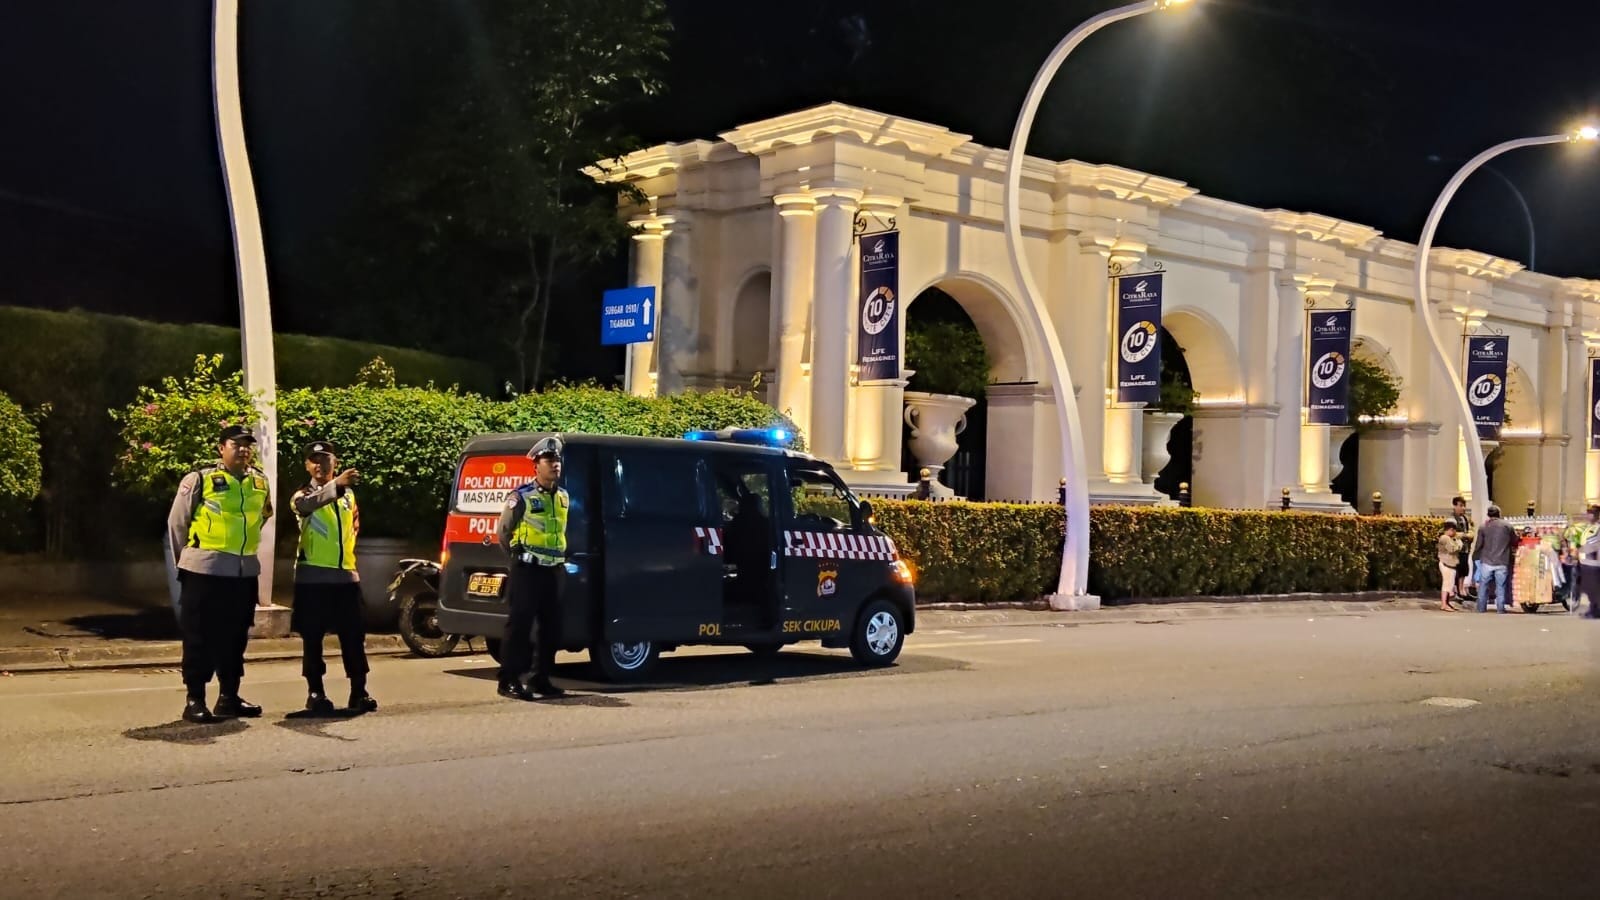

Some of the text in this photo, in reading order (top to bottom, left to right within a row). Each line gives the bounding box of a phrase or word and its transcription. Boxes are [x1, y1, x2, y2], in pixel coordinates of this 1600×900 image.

[869, 298, 883, 317] 10
[1129, 331, 1145, 348] 10
[1319, 361, 1335, 376] 10
[1476, 382, 1491, 395] 10
[463, 476, 495, 489] POLRI
[698, 618, 841, 637] POL SEK CIKUPA
